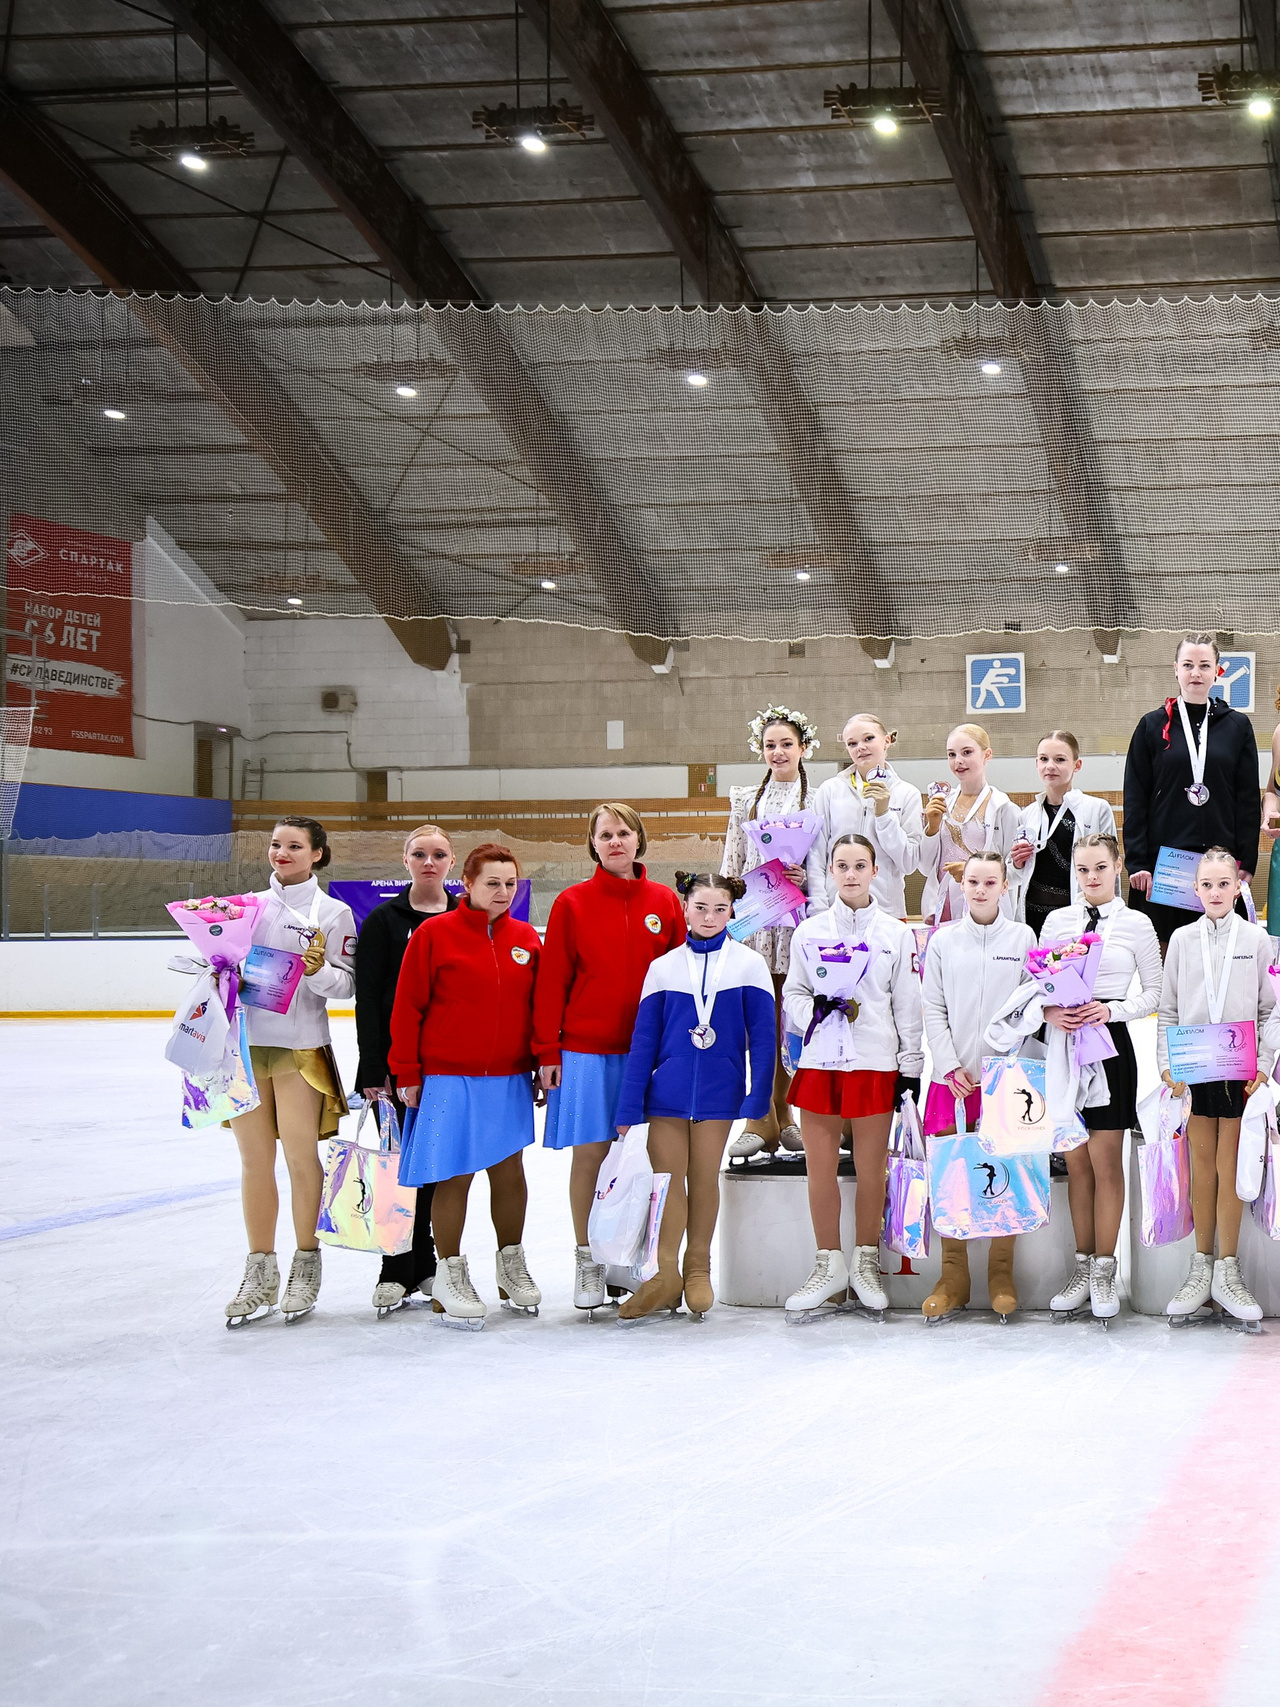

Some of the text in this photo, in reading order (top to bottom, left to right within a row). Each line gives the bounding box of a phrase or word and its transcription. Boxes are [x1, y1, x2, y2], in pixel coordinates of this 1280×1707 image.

[59, 548, 124, 574] СПАРТАК
[24, 601, 101, 627] НАБОР ДЕТЕЙ
[60, 625, 101, 652] ЛЕТ
[179, 1022, 206, 1043] martavia
